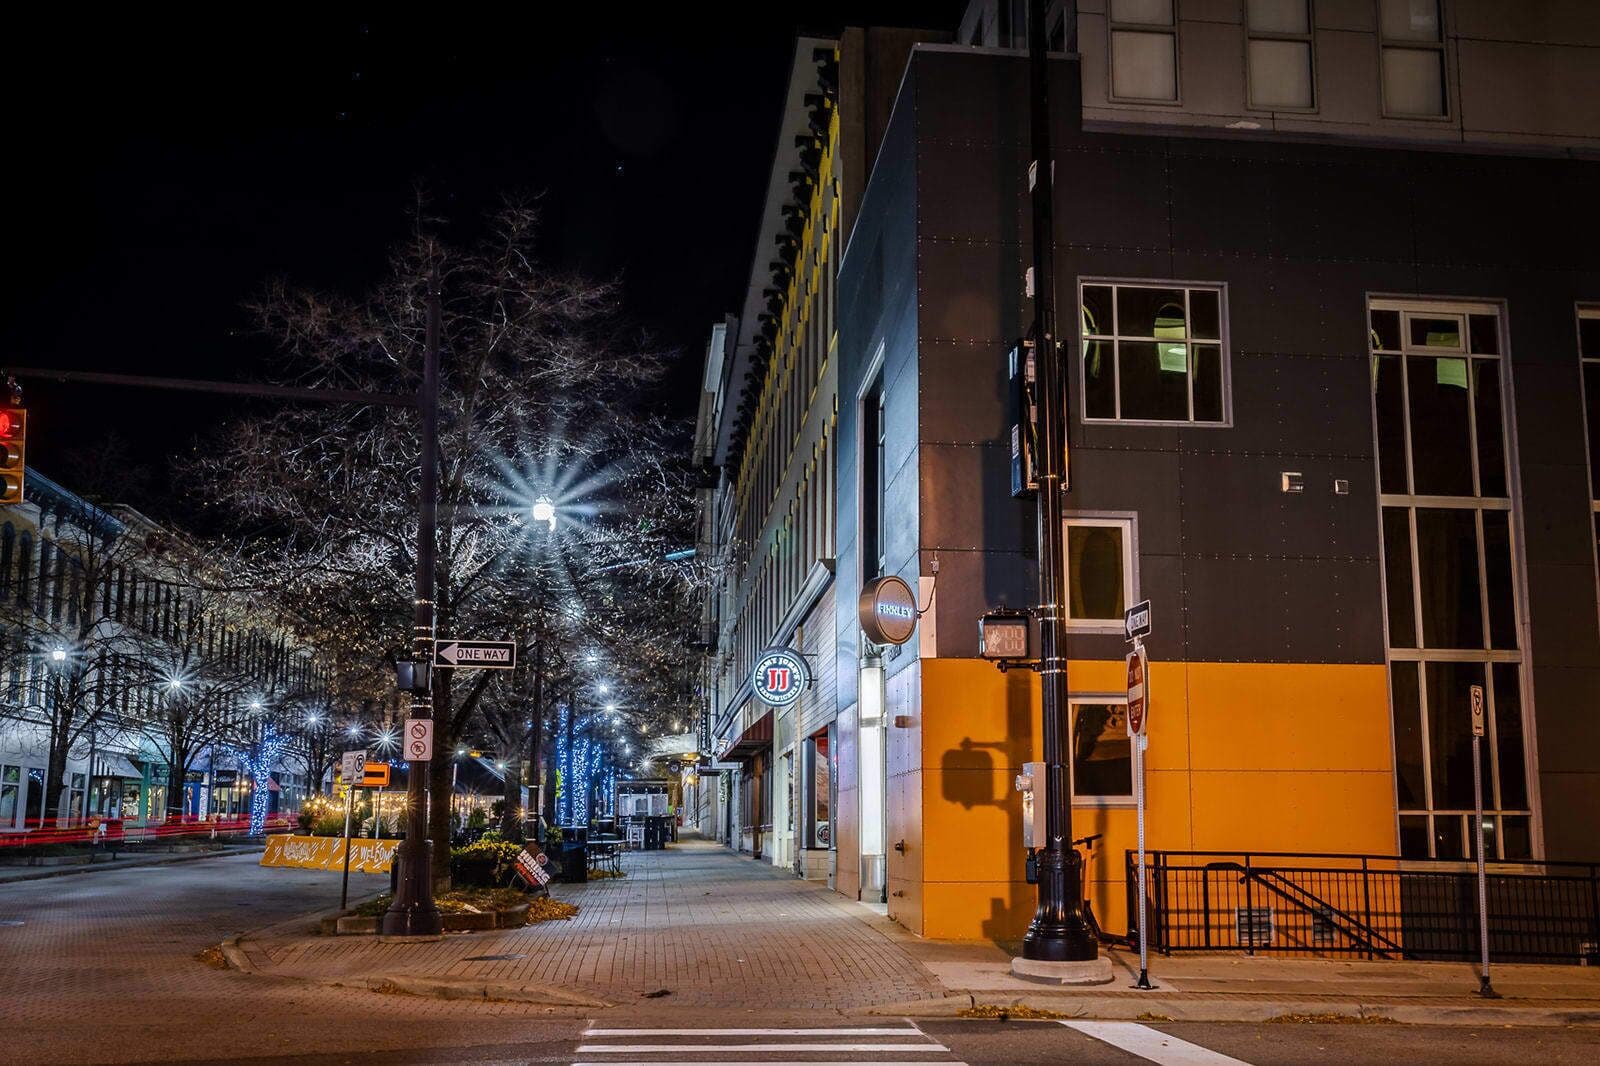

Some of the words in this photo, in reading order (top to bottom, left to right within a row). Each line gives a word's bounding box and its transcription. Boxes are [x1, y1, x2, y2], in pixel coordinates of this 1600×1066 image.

[456, 649, 480, 659] ONE
[484, 650, 506, 660] WAY
[769, 669, 788, 691] JJ
[519, 849, 550, 884] HIRING
